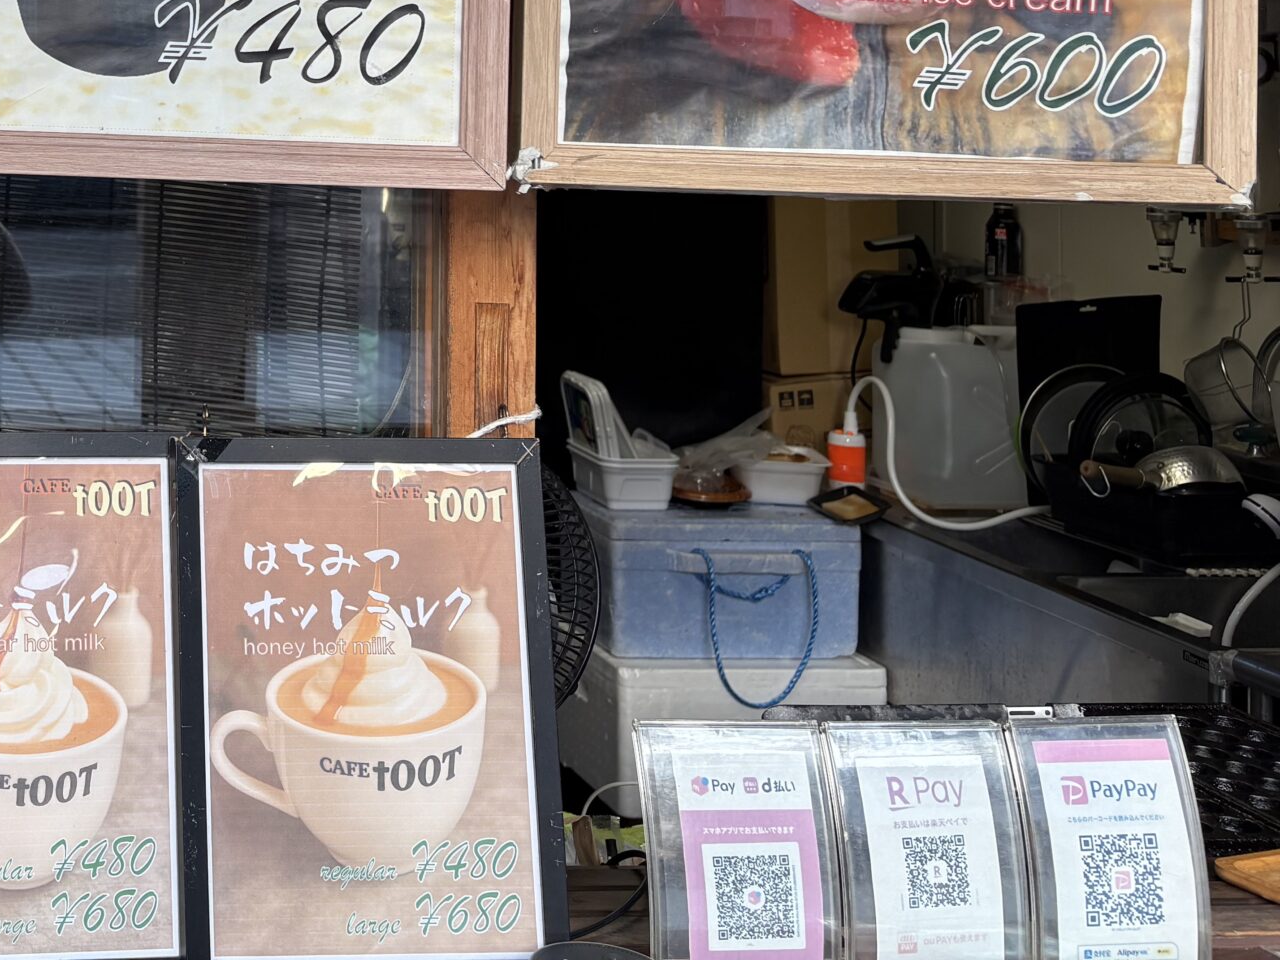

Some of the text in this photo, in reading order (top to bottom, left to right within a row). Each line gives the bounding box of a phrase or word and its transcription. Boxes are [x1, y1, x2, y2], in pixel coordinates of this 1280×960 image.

[905, 19, 1167, 118] ¥600
[23, 477, 72, 494] CAFE
[243, 539, 400, 576] はちみつ
[243, 586, 472, 632] ホットミルク
[24, 634, 58, 652] hot
[64, 634, 105, 652] milk
[243, 637, 395, 659] honey hot milk
[319, 756, 371, 778] CAFE
[711, 778, 736, 795] Pay
[761, 777, 797, 793] d払い
[913, 776, 964, 808] Pay
[1089, 779, 1158, 801] PayPay
[50, 835, 157, 882] ¥480
[320, 838, 519, 890] regular ¥480
[51, 888, 159, 936] ¥680
[346, 891, 521, 945] large ¥680
